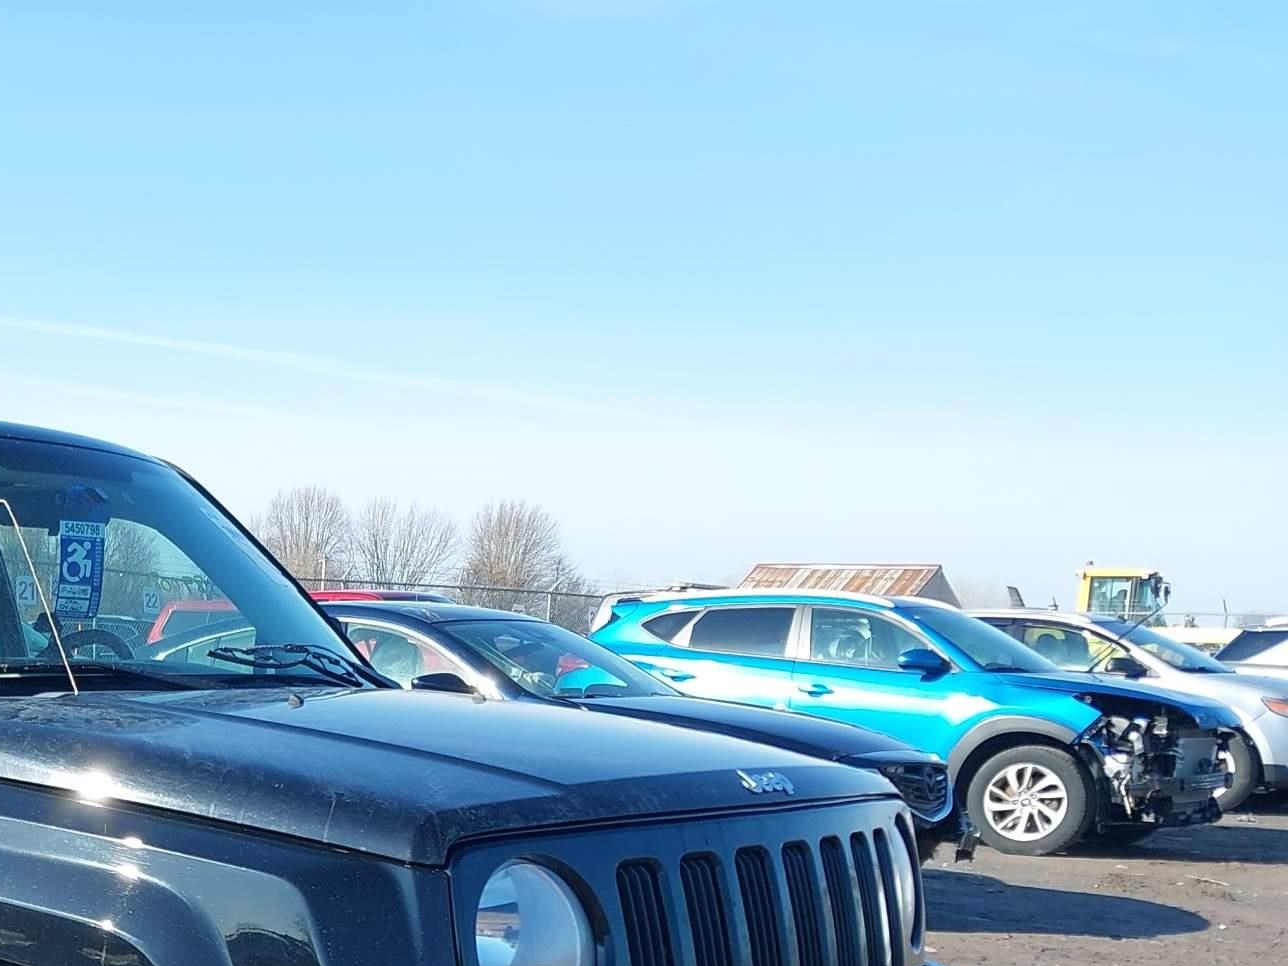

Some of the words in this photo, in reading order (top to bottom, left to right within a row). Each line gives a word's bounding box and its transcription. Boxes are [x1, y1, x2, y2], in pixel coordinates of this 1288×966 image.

[64, 522, 101, 536] 5450798
[18, 581, 35, 601] 21
[144, 592, 158, 609] 22
[735, 768, 794, 796] Jeep
